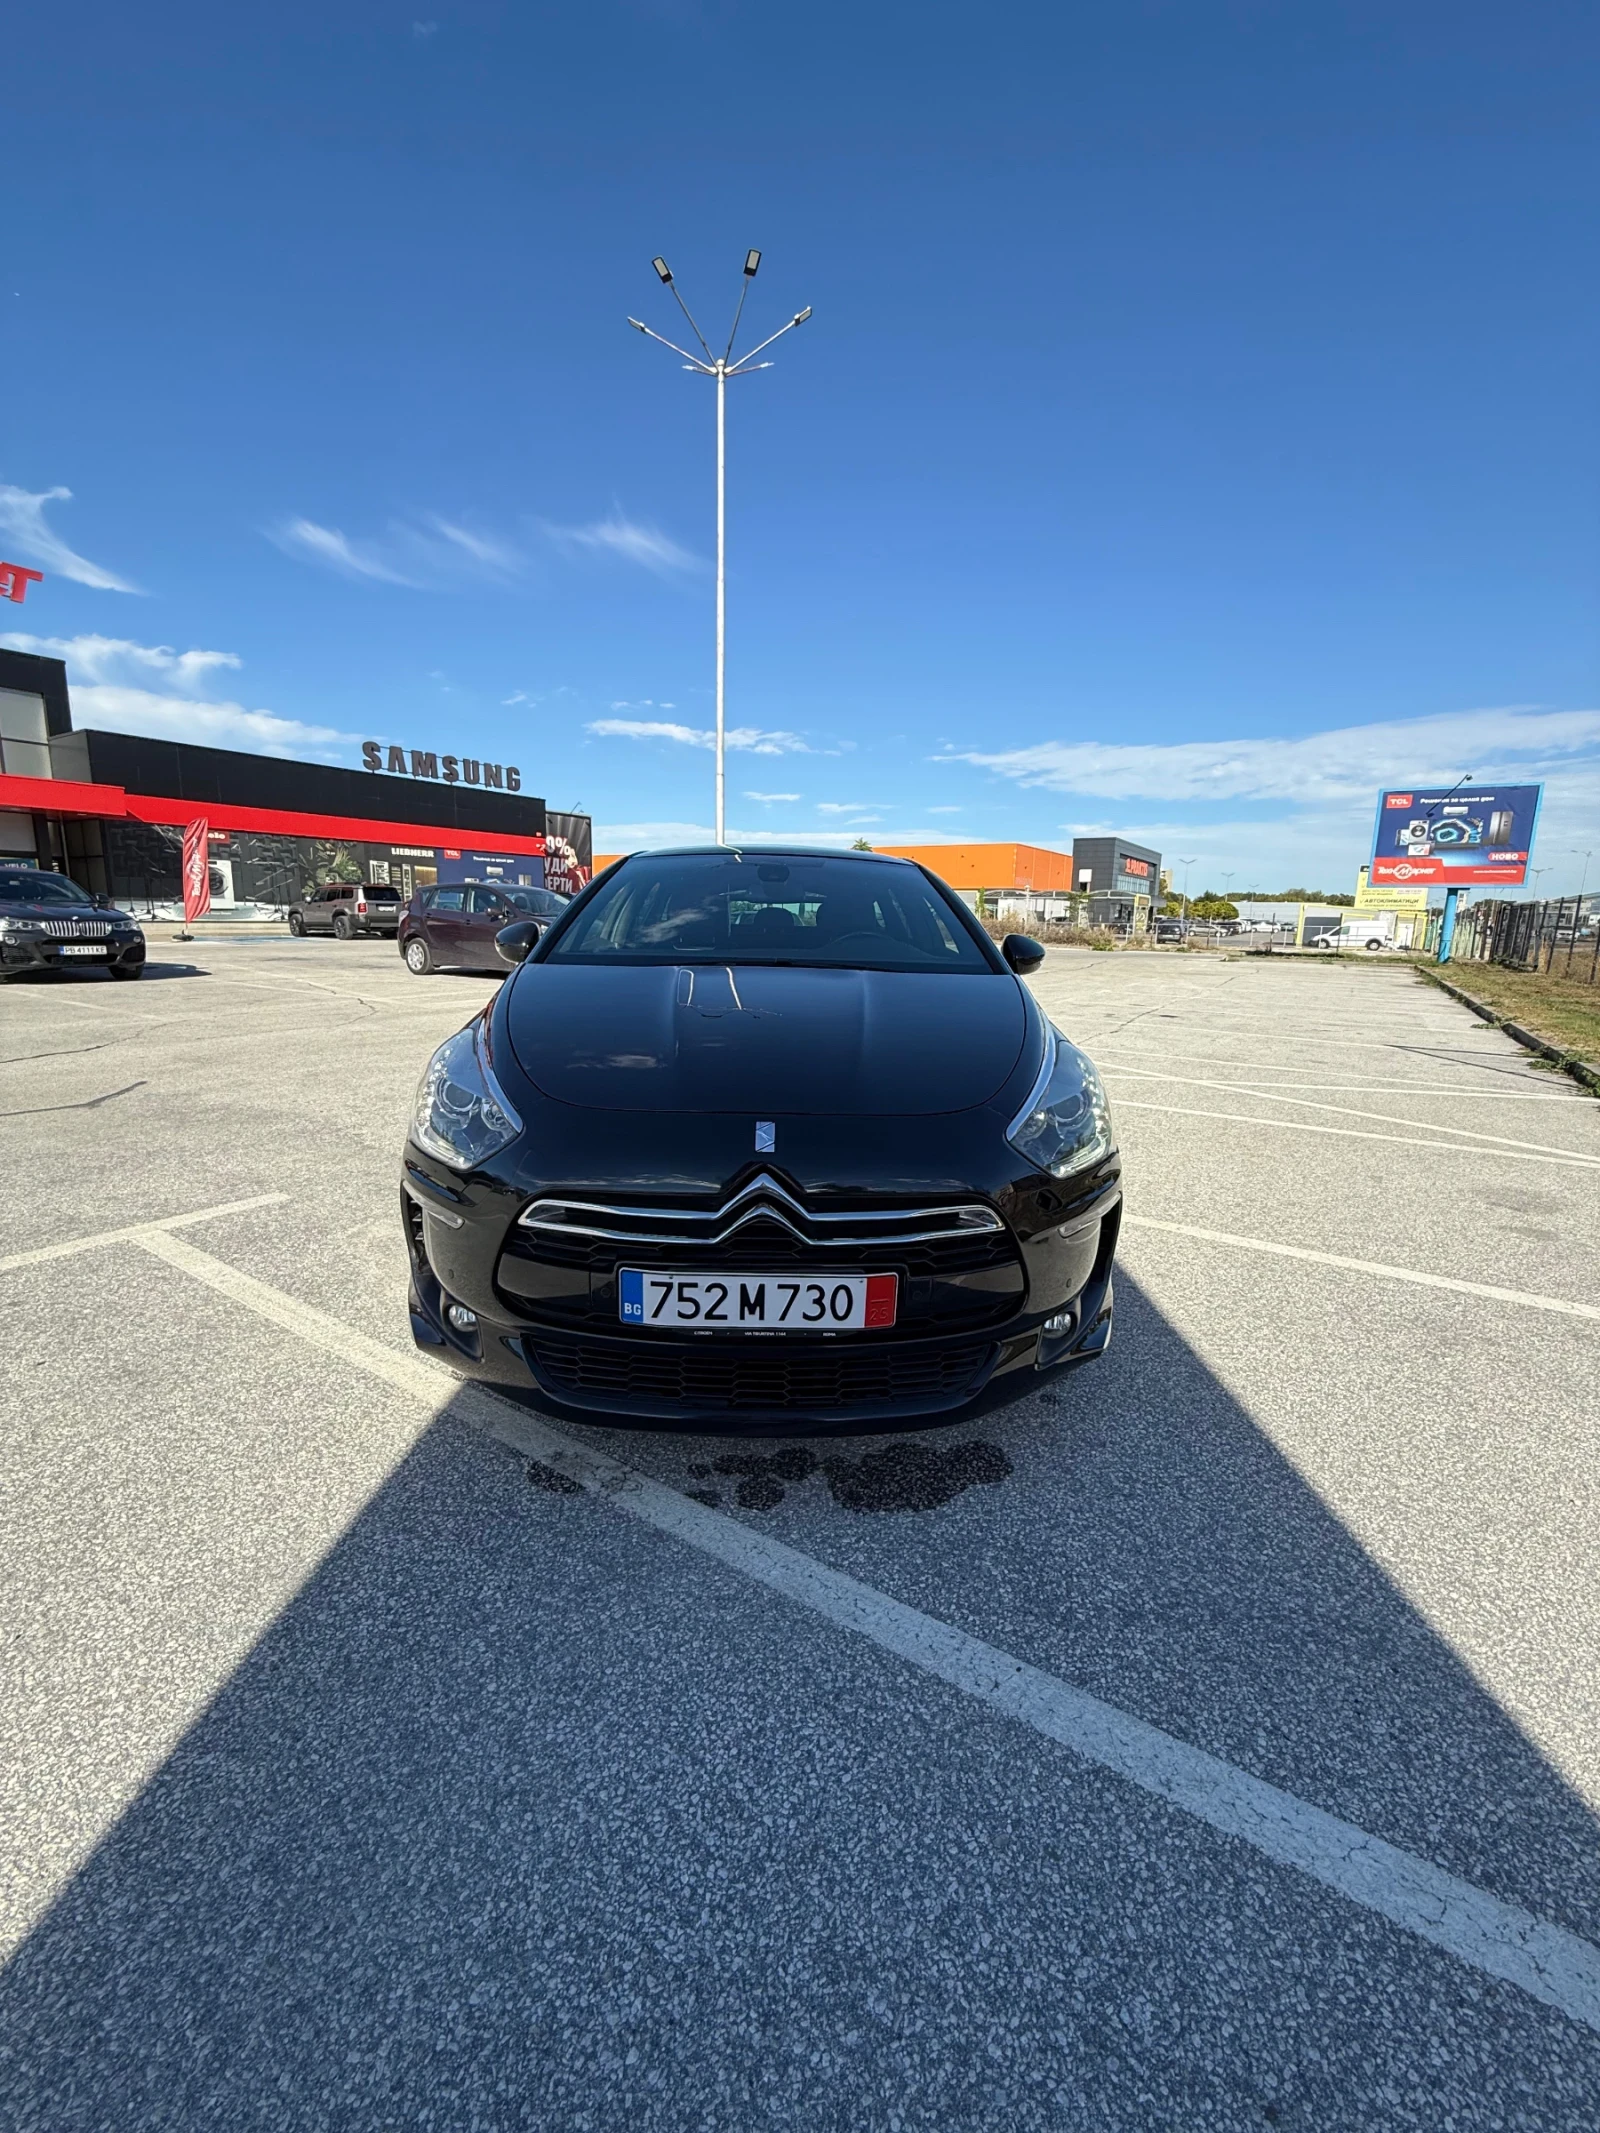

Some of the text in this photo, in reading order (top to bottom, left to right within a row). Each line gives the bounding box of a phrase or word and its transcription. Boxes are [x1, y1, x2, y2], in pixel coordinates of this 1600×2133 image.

[362, 741, 521, 792] SAMSUNG
[391, 847, 434, 858] LIEBHERR
[544, 857, 568, 880] УДИ
[624, 1302, 641, 1315] BG
[650, 1281, 853, 1321] 752 M 730
[870, 1307, 889, 1320] 25
